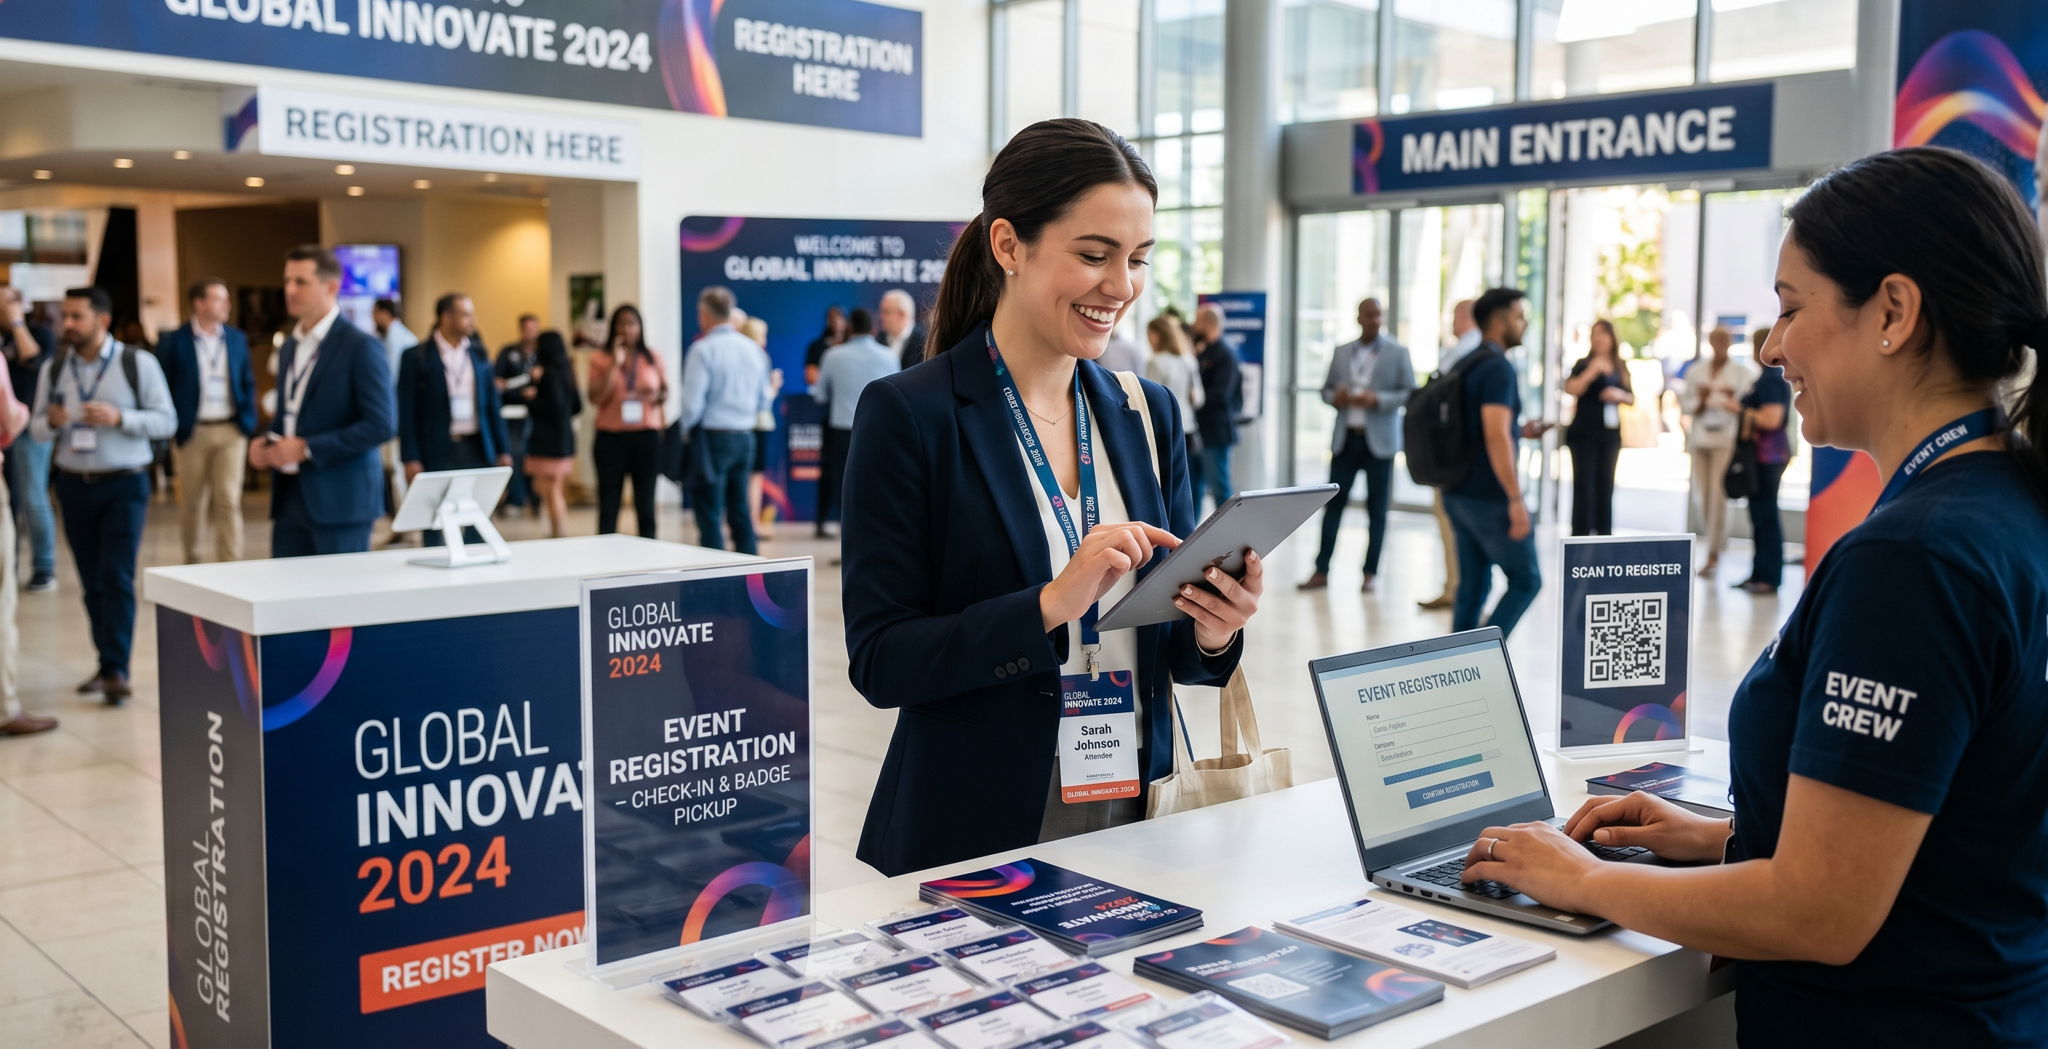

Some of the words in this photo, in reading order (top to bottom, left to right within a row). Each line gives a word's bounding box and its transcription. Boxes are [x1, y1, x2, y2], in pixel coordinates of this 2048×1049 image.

[358, 0, 558, 62] INNOVATE
[563, 22, 654, 73] 2024
[734, 17, 913, 76] REGISTRATION
[793, 61, 861, 102] HERE
[285, 106, 536, 158] REGISTRATION
[545, 131, 624, 164] HERE
[1402, 127, 1500, 174] MAIN
[1510, 106, 1736, 165] ENTRANCE
[794, 235, 880, 256] WELCOME
[881, 236, 906, 257] TO
[724, 255, 811, 281] GLOBAL
[813, 257, 917, 283] INNOVATE
[1903, 444, 1936, 477] EVENT
[1936, 423, 1969, 450] CREW
[1571, 565, 1605, 579] SCAN
[1607, 565, 1624, 578] TO
[1625, 563, 1682, 577] REGISTER
[607, 600, 683, 631] GLOBAL
[608, 621, 715, 654] INNOVATE
[609, 651, 662, 680] 2024
[1357, 681, 1397, 705] EVENT
[1398, 665, 1482, 696] REGISTRATION
[1064, 690, 1091, 701] GLOBAL
[1064, 697, 1103, 709] INNOVATE
[1104, 696, 1123, 706] 2024
[1825, 670, 1918, 715] EVENT
[353, 700, 550, 781] GLOBAL
[663, 707, 747, 744] EVENT
[1081, 723, 1112, 736] Sarah
[1822, 701, 1904, 743] CREW
[609, 730, 797, 785] REGISTRATION
[1074, 738, 1121, 752] Johnson
[1084, 751, 1113, 761] Attendee
[356, 761, 583, 847] INNOVA
[631, 776, 715, 809] CHECK-IN
[718, 774, 731, 793] &
[734, 763, 792, 791] BADGE
[673, 796, 738, 826] PICKUP
[206, 711, 232, 1024] REGISTRATION
[357, 835, 512, 915] 2024
[192, 831, 215, 1006] GLOBAL
[381, 939, 526, 994] REGISTER
